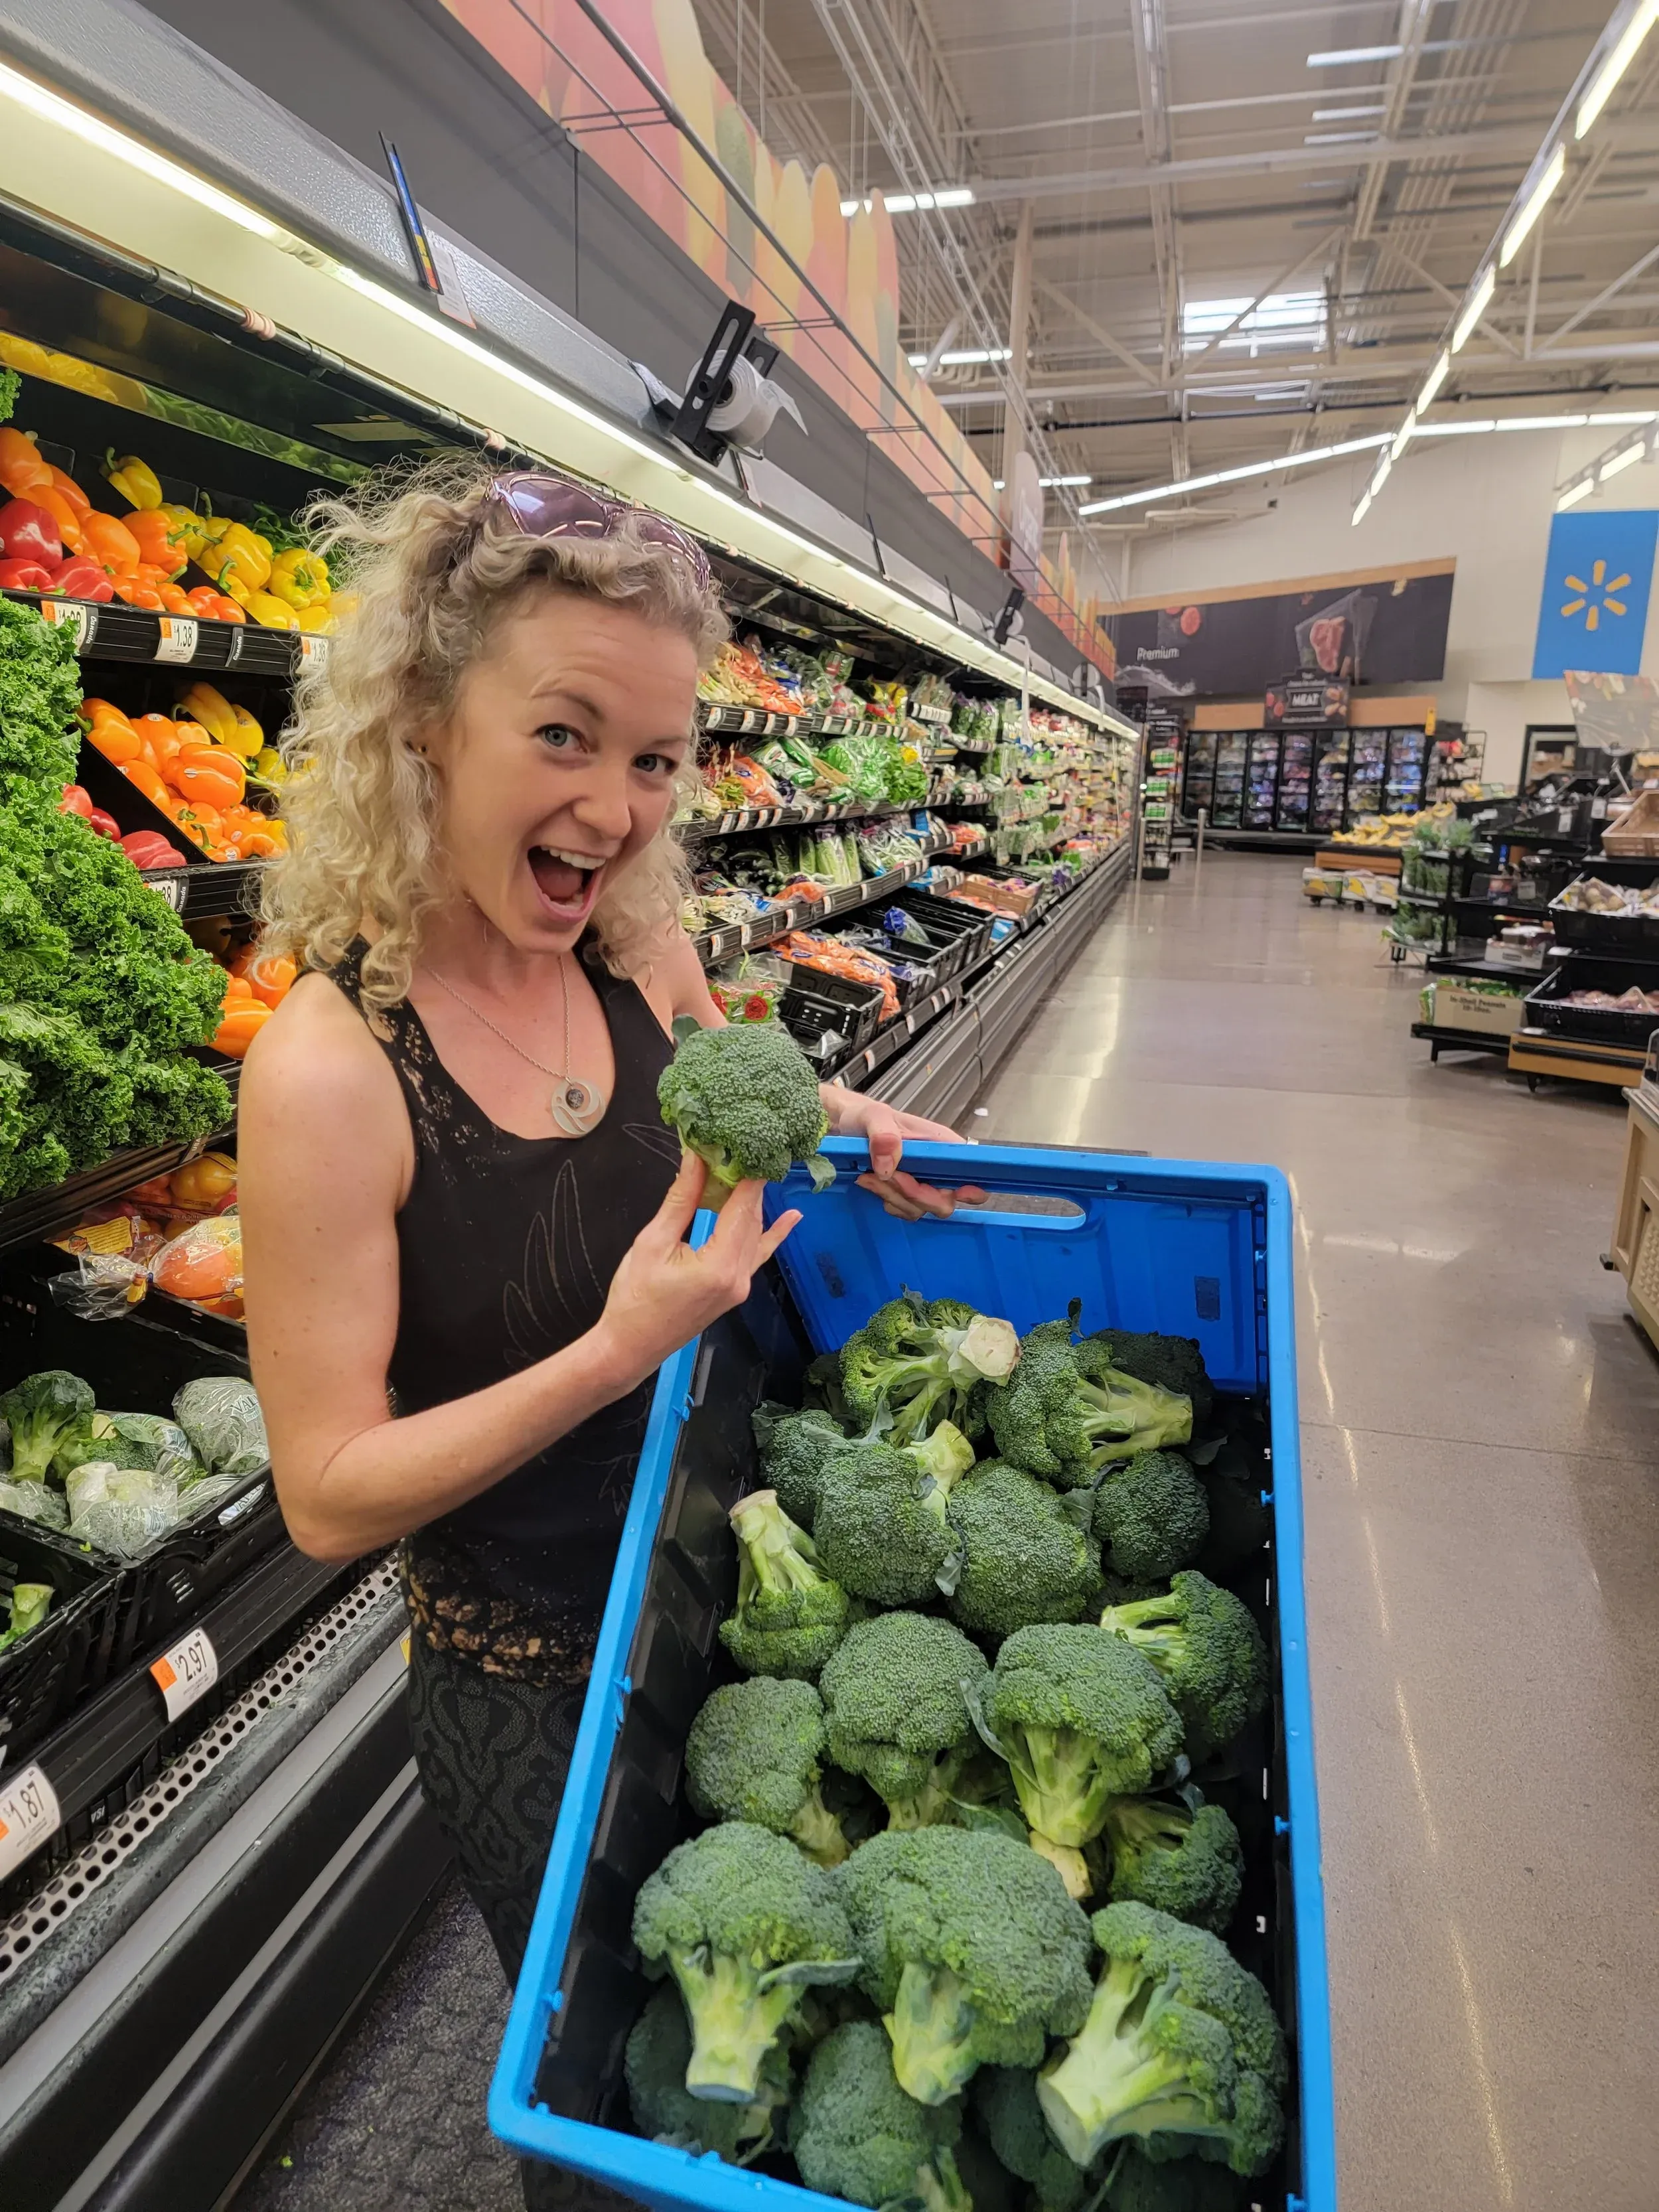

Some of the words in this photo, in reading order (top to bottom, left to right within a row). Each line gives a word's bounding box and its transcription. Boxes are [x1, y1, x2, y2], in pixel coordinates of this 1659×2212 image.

[86, 615, 98, 644] Canada
[233, 636, 242, 660] Canada
[1137, 646, 1179, 660] Premium
[1292, 693, 1319, 706] MEAT
[177, 886, 186, 913] Canada
[175, 1641, 207, 1682] $2.97
[3, 1780, 44, 1828] $1.87
